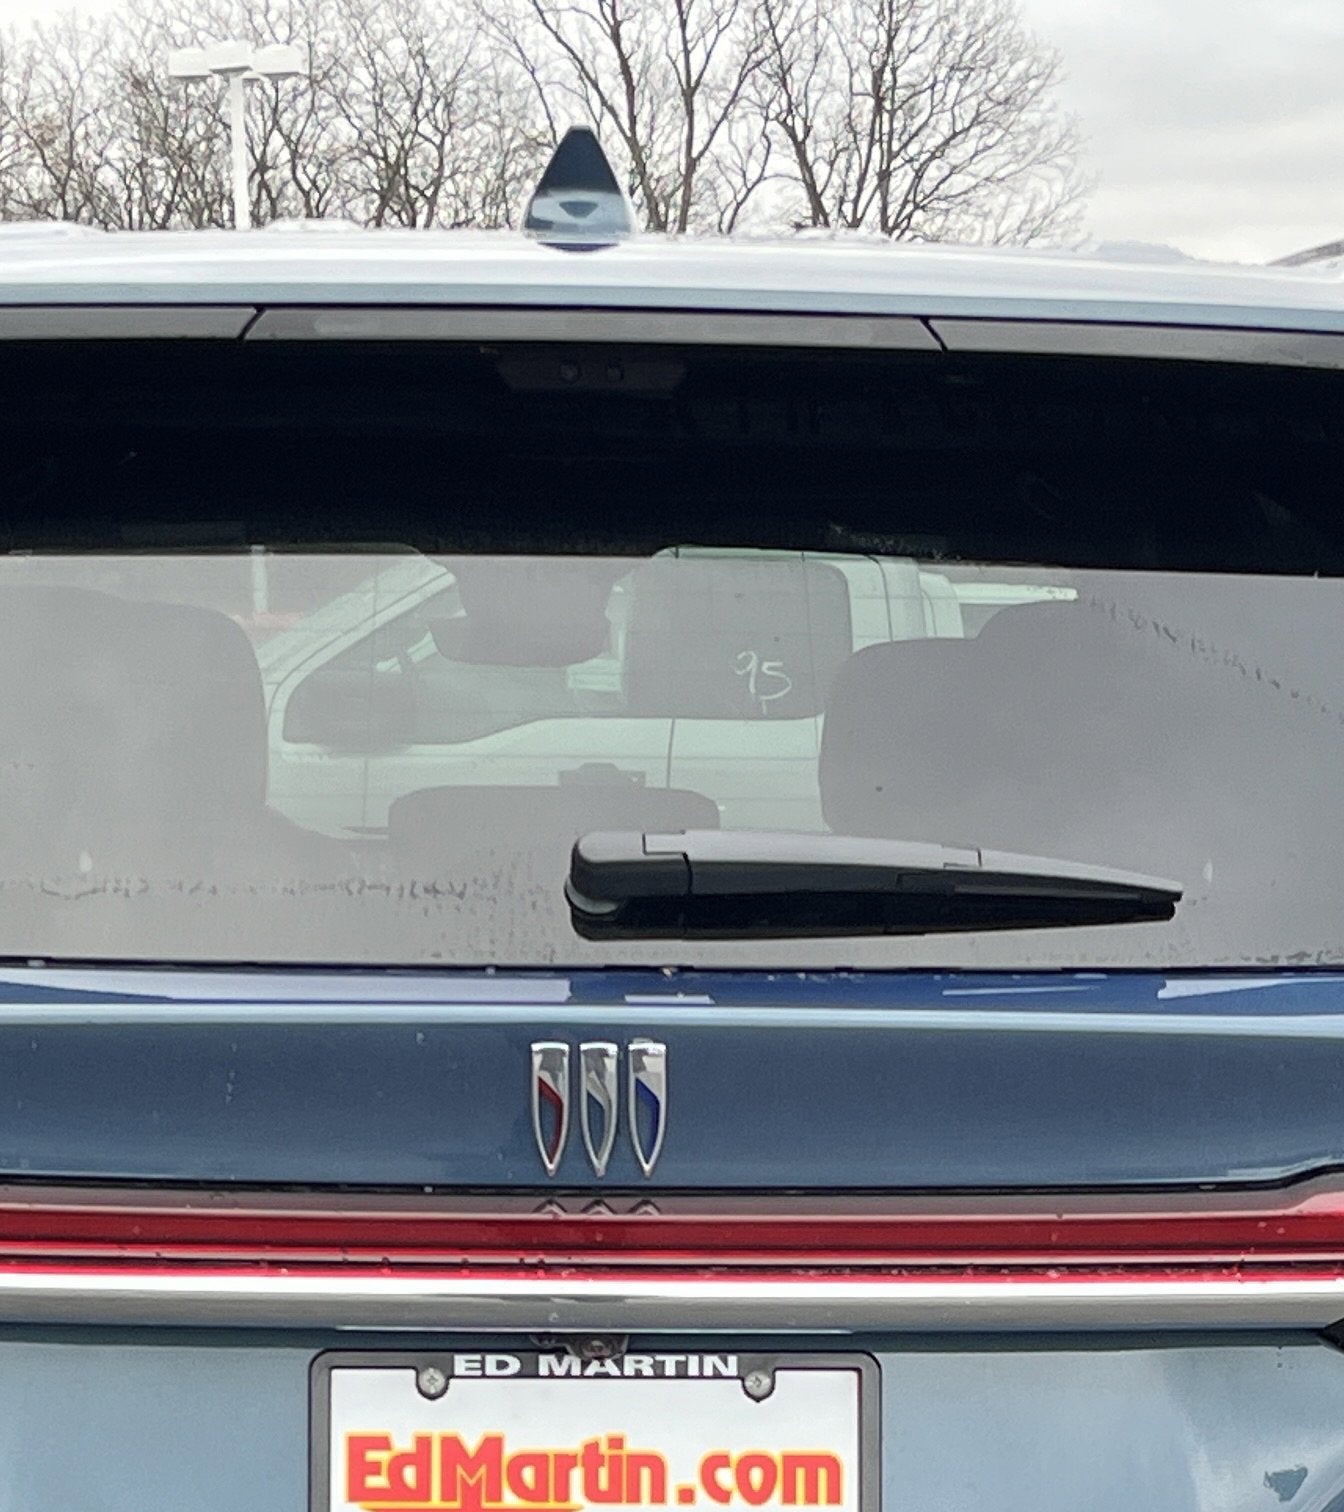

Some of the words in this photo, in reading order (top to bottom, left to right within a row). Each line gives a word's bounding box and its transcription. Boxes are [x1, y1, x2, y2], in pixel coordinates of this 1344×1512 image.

[453, 1353, 521, 1377] ED
[538, 1353, 739, 1377] MARTIN
[344, 1432, 843, 1505] EdMartin.com
